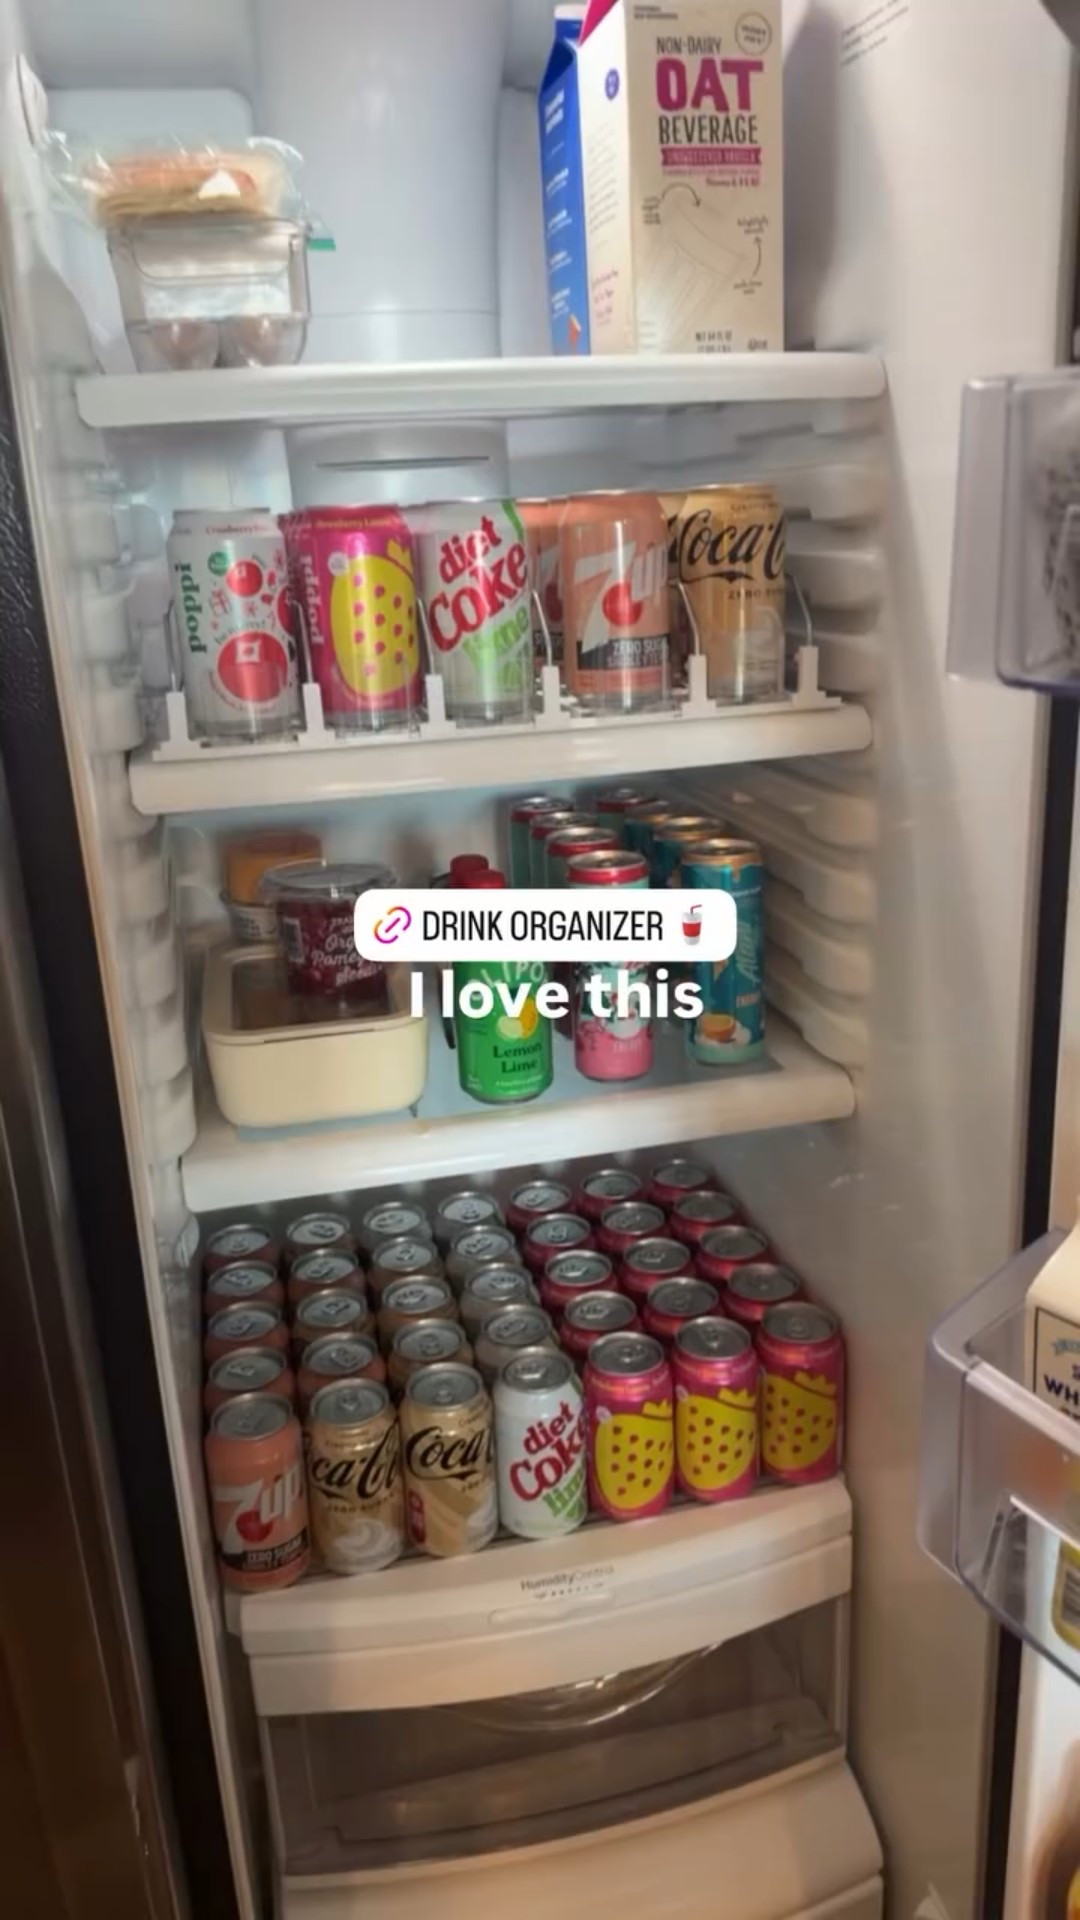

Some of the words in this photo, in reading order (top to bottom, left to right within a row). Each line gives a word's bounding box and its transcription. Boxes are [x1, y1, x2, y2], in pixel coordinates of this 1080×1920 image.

[656, 36, 722, 54] NON-DAIRY
[656, 57, 764, 112] OAT
[658, 114, 759, 145] BEVERAGE
[439, 515, 502, 584] diet
[174, 563, 207, 654] poppi
[428, 543, 527, 652] Coke
[492, 1042, 543, 1058] Lemon
[501, 1059, 537, 1073] Lime
[524, 1401, 574, 1455] diet
